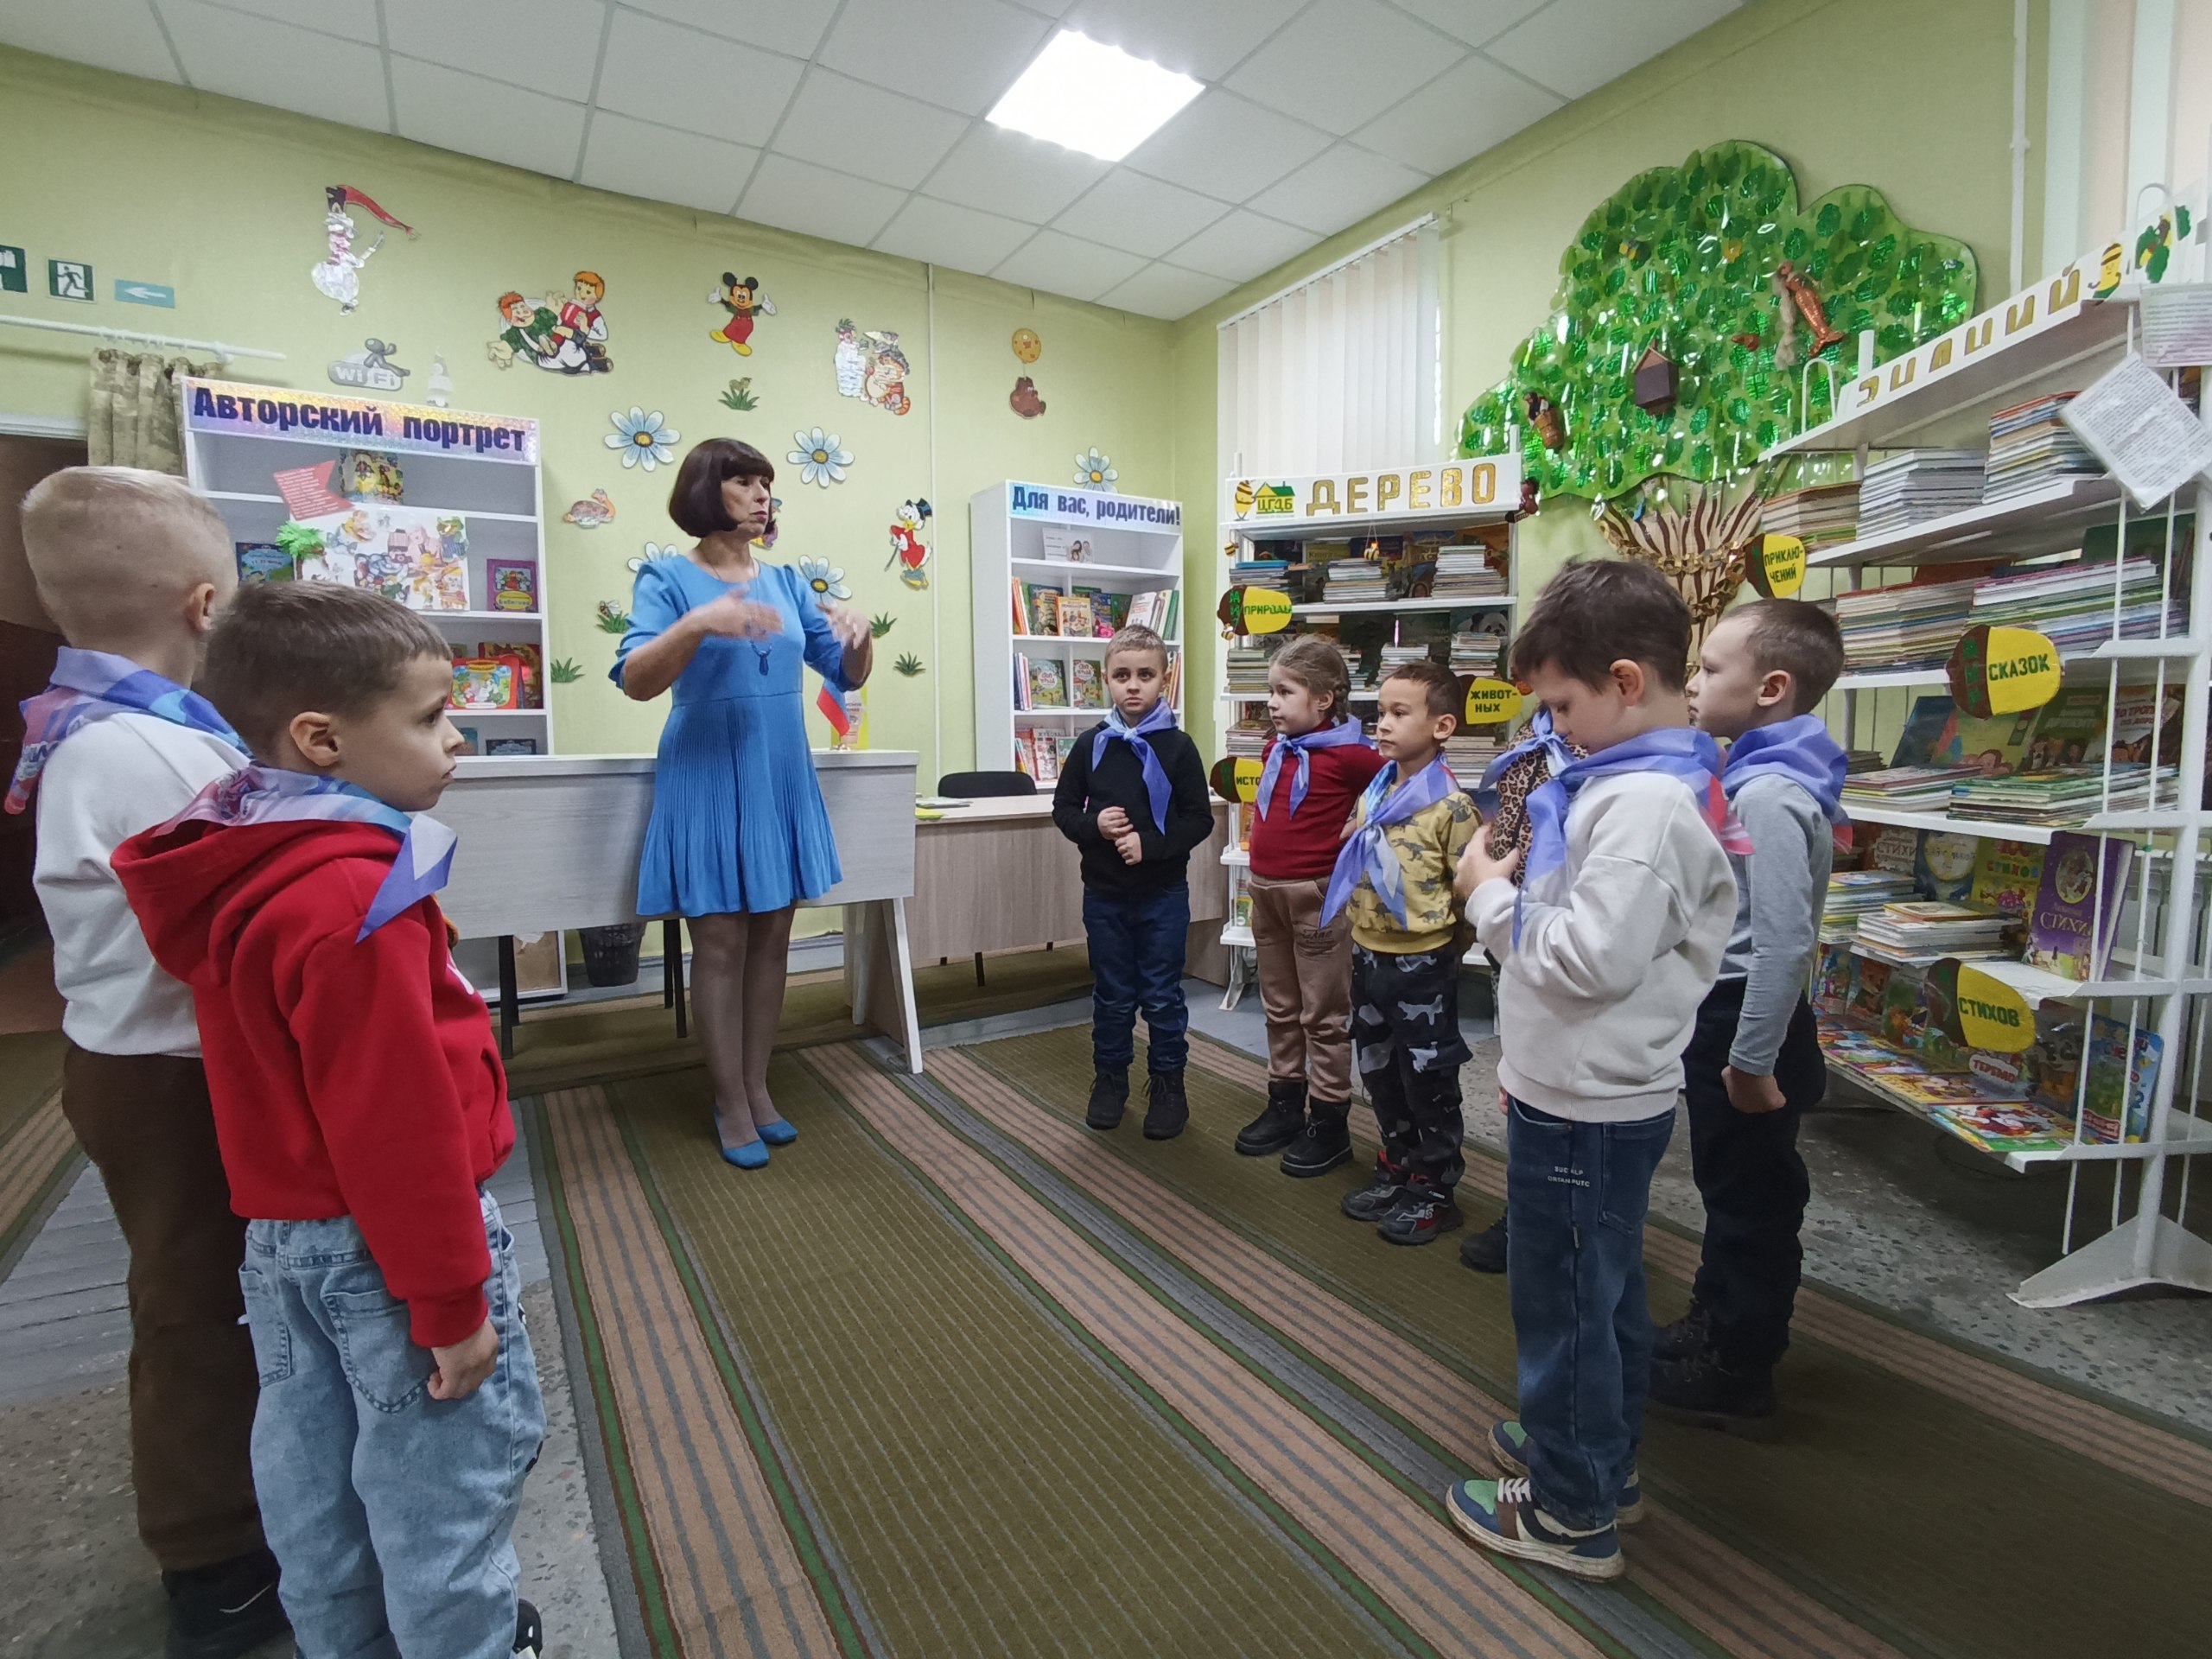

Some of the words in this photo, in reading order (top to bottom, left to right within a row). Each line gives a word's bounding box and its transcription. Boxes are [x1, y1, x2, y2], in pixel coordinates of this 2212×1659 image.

[194, 387, 383, 435] Авторский
[403, 415, 525, 453] портрет
[1306, 462, 1497, 517] ДЕРЕВО
[1012, 486, 1049, 511] Для
[1058, 495, 1090, 518] вас,
[1096, 499, 1180, 525] родители!
[1764, 545, 1803, 567] ПРИКЛЮ-
[1770, 563, 1796, 583] ЧЕНИЙ
[1988, 653, 2050, 681] СКАЗОК
[1471, 690, 1517, 700] ЖИВОТ-
[1475, 703, 1500, 713] НЫХ
[1958, 997, 2020, 1027] СТИХОВ
